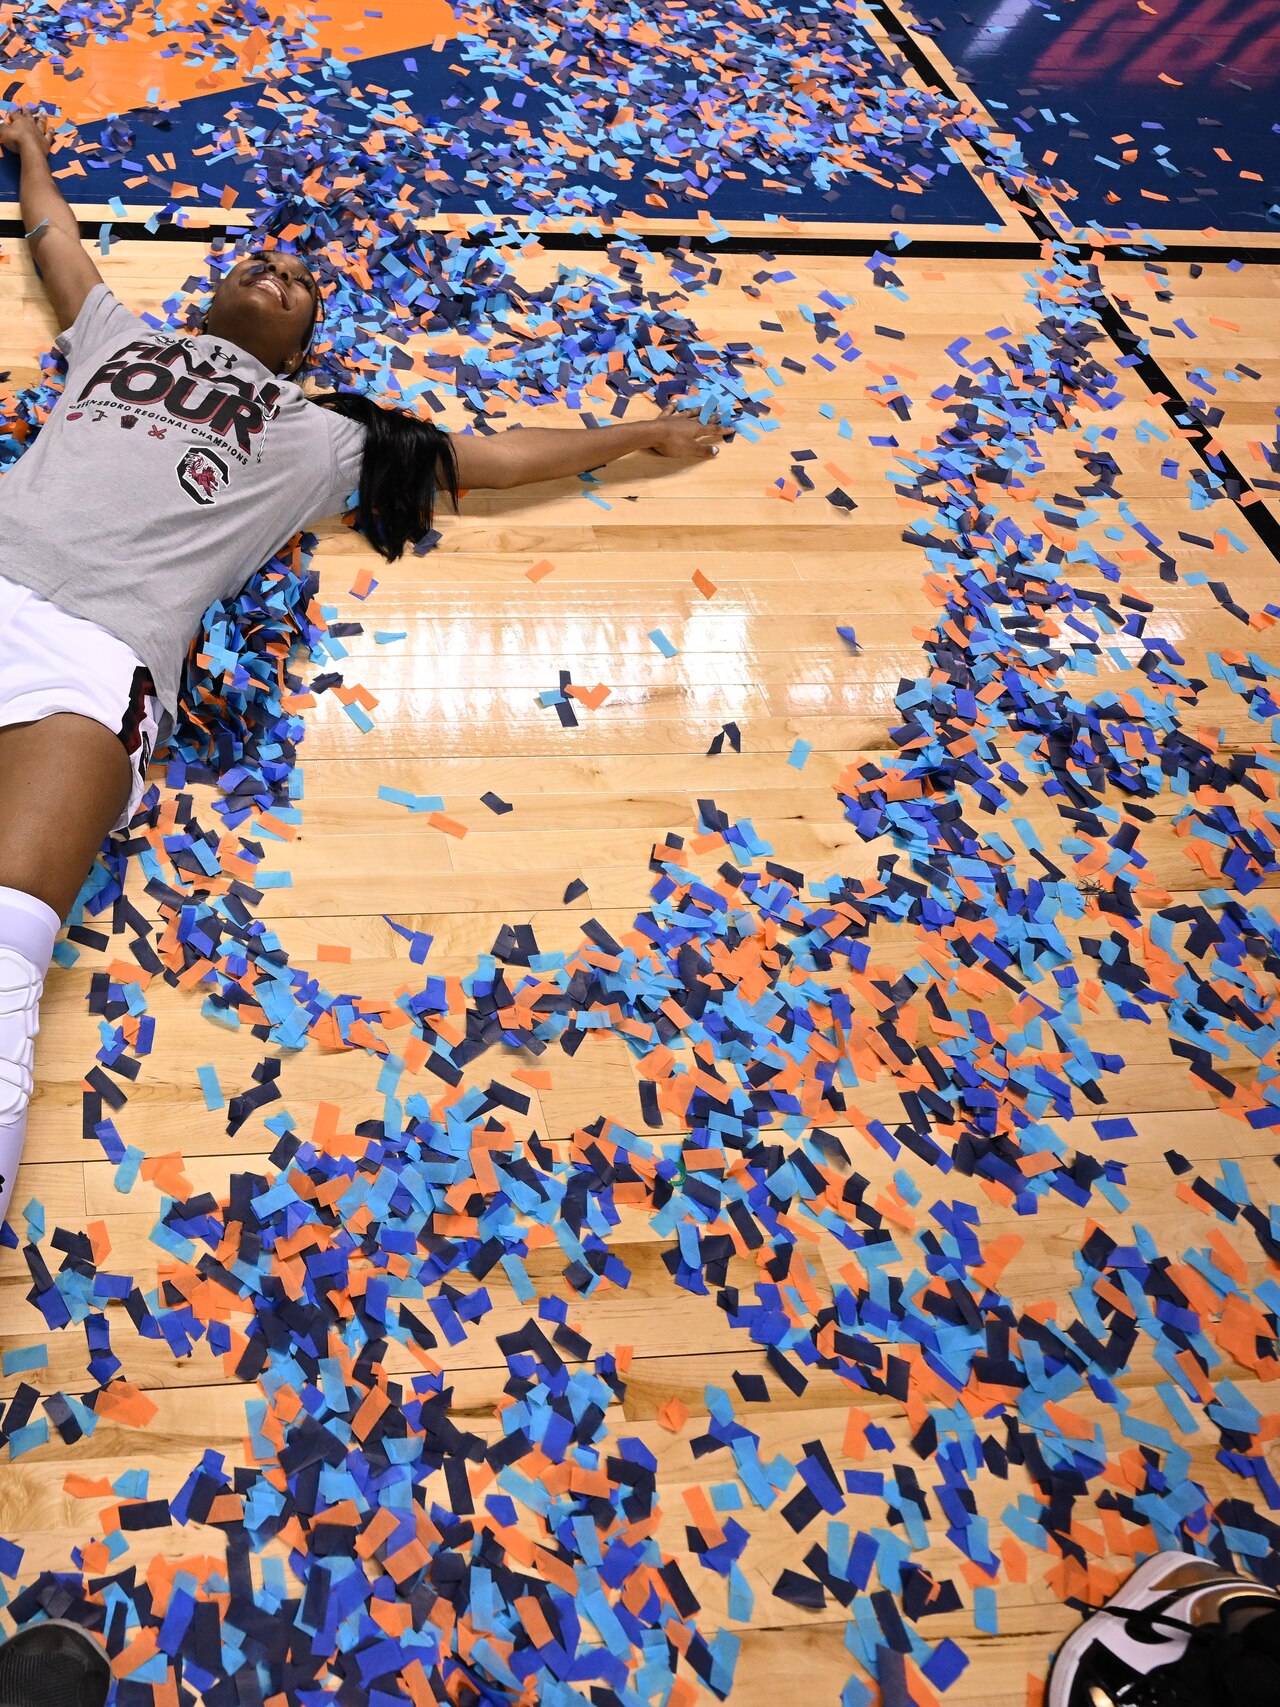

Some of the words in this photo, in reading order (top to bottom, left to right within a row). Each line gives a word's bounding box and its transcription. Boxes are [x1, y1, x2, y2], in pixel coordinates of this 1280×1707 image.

[77, 361, 266, 455] FOUR
[134, 408, 187, 430] REGIONAL
[191, 427, 249, 466] CHAMPIONS
